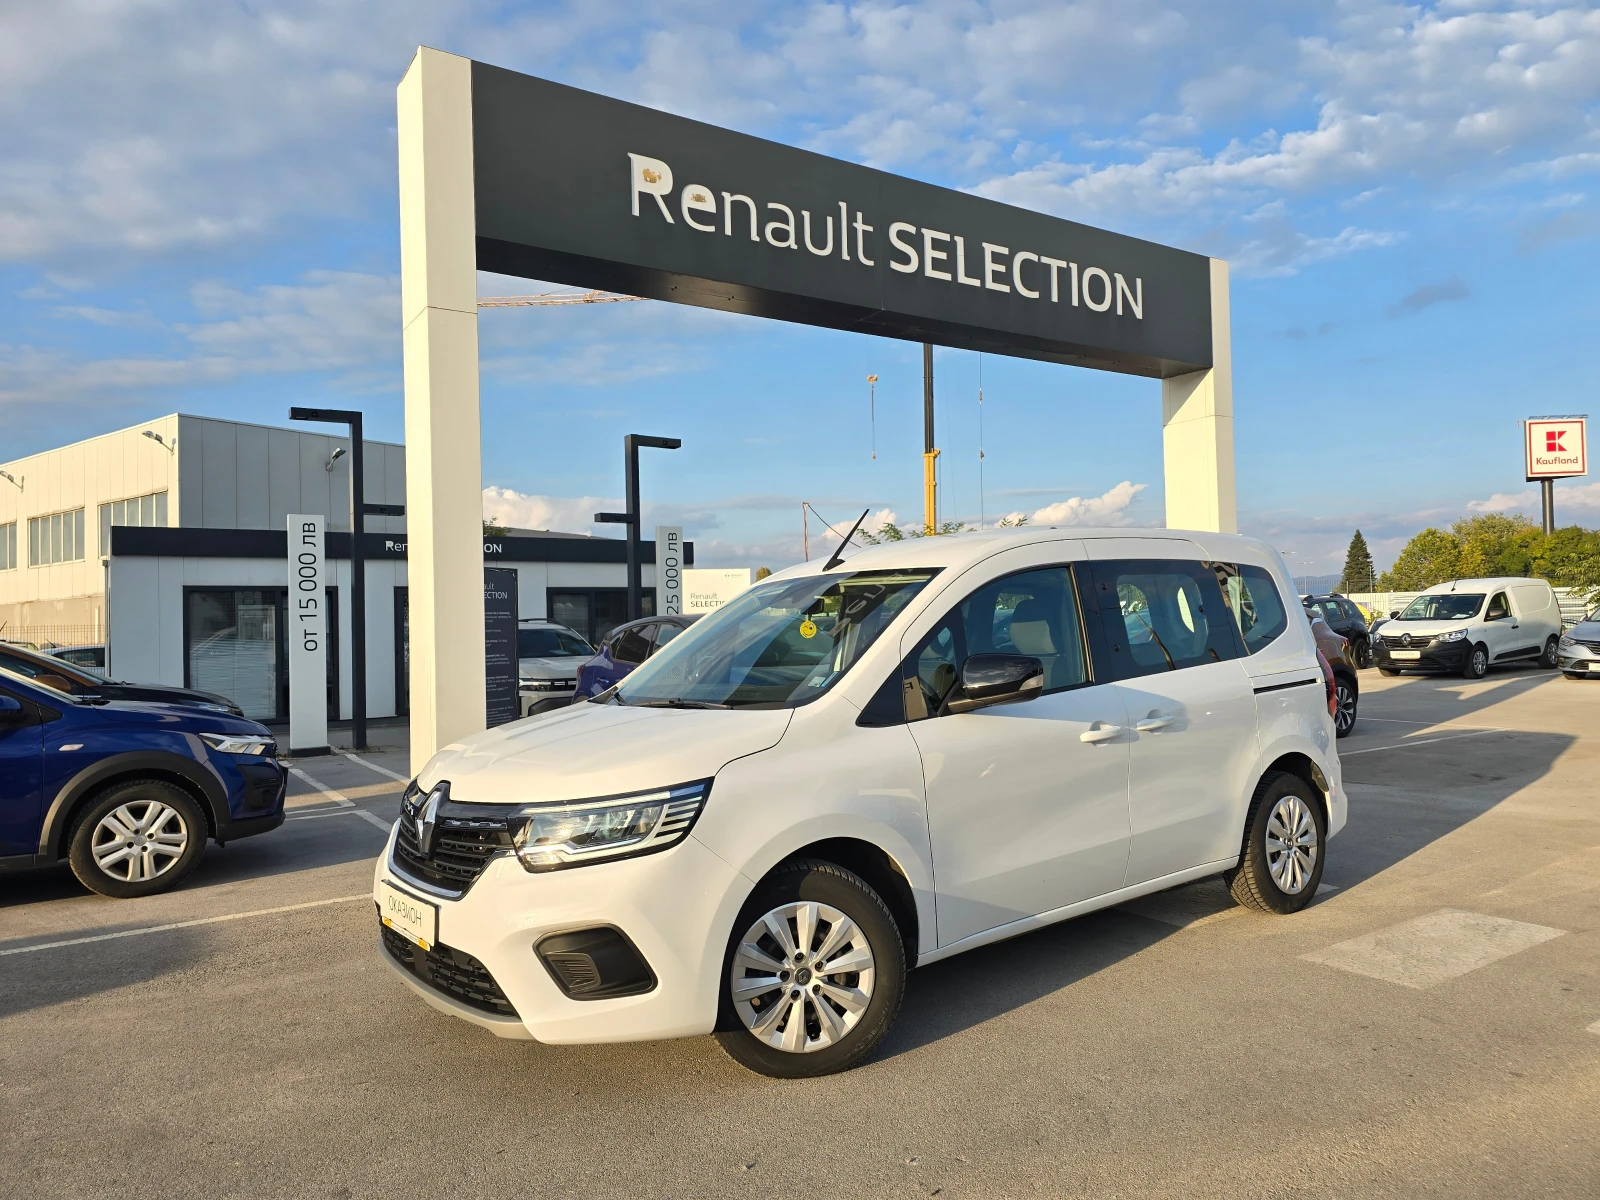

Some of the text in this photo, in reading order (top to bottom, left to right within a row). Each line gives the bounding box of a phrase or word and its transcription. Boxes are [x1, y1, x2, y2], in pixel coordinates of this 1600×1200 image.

[627, 152, 1143, 320] Renault SELECTION
[1536, 456, 1579, 465] Kaufland
[298, 553, 317, 592] 000
[665, 557, 679, 590] 000
[299, 599, 318, 622] 15
[666, 594, 679, 616] 25
[388, 895, 422, 928] ОКАЗИОН
